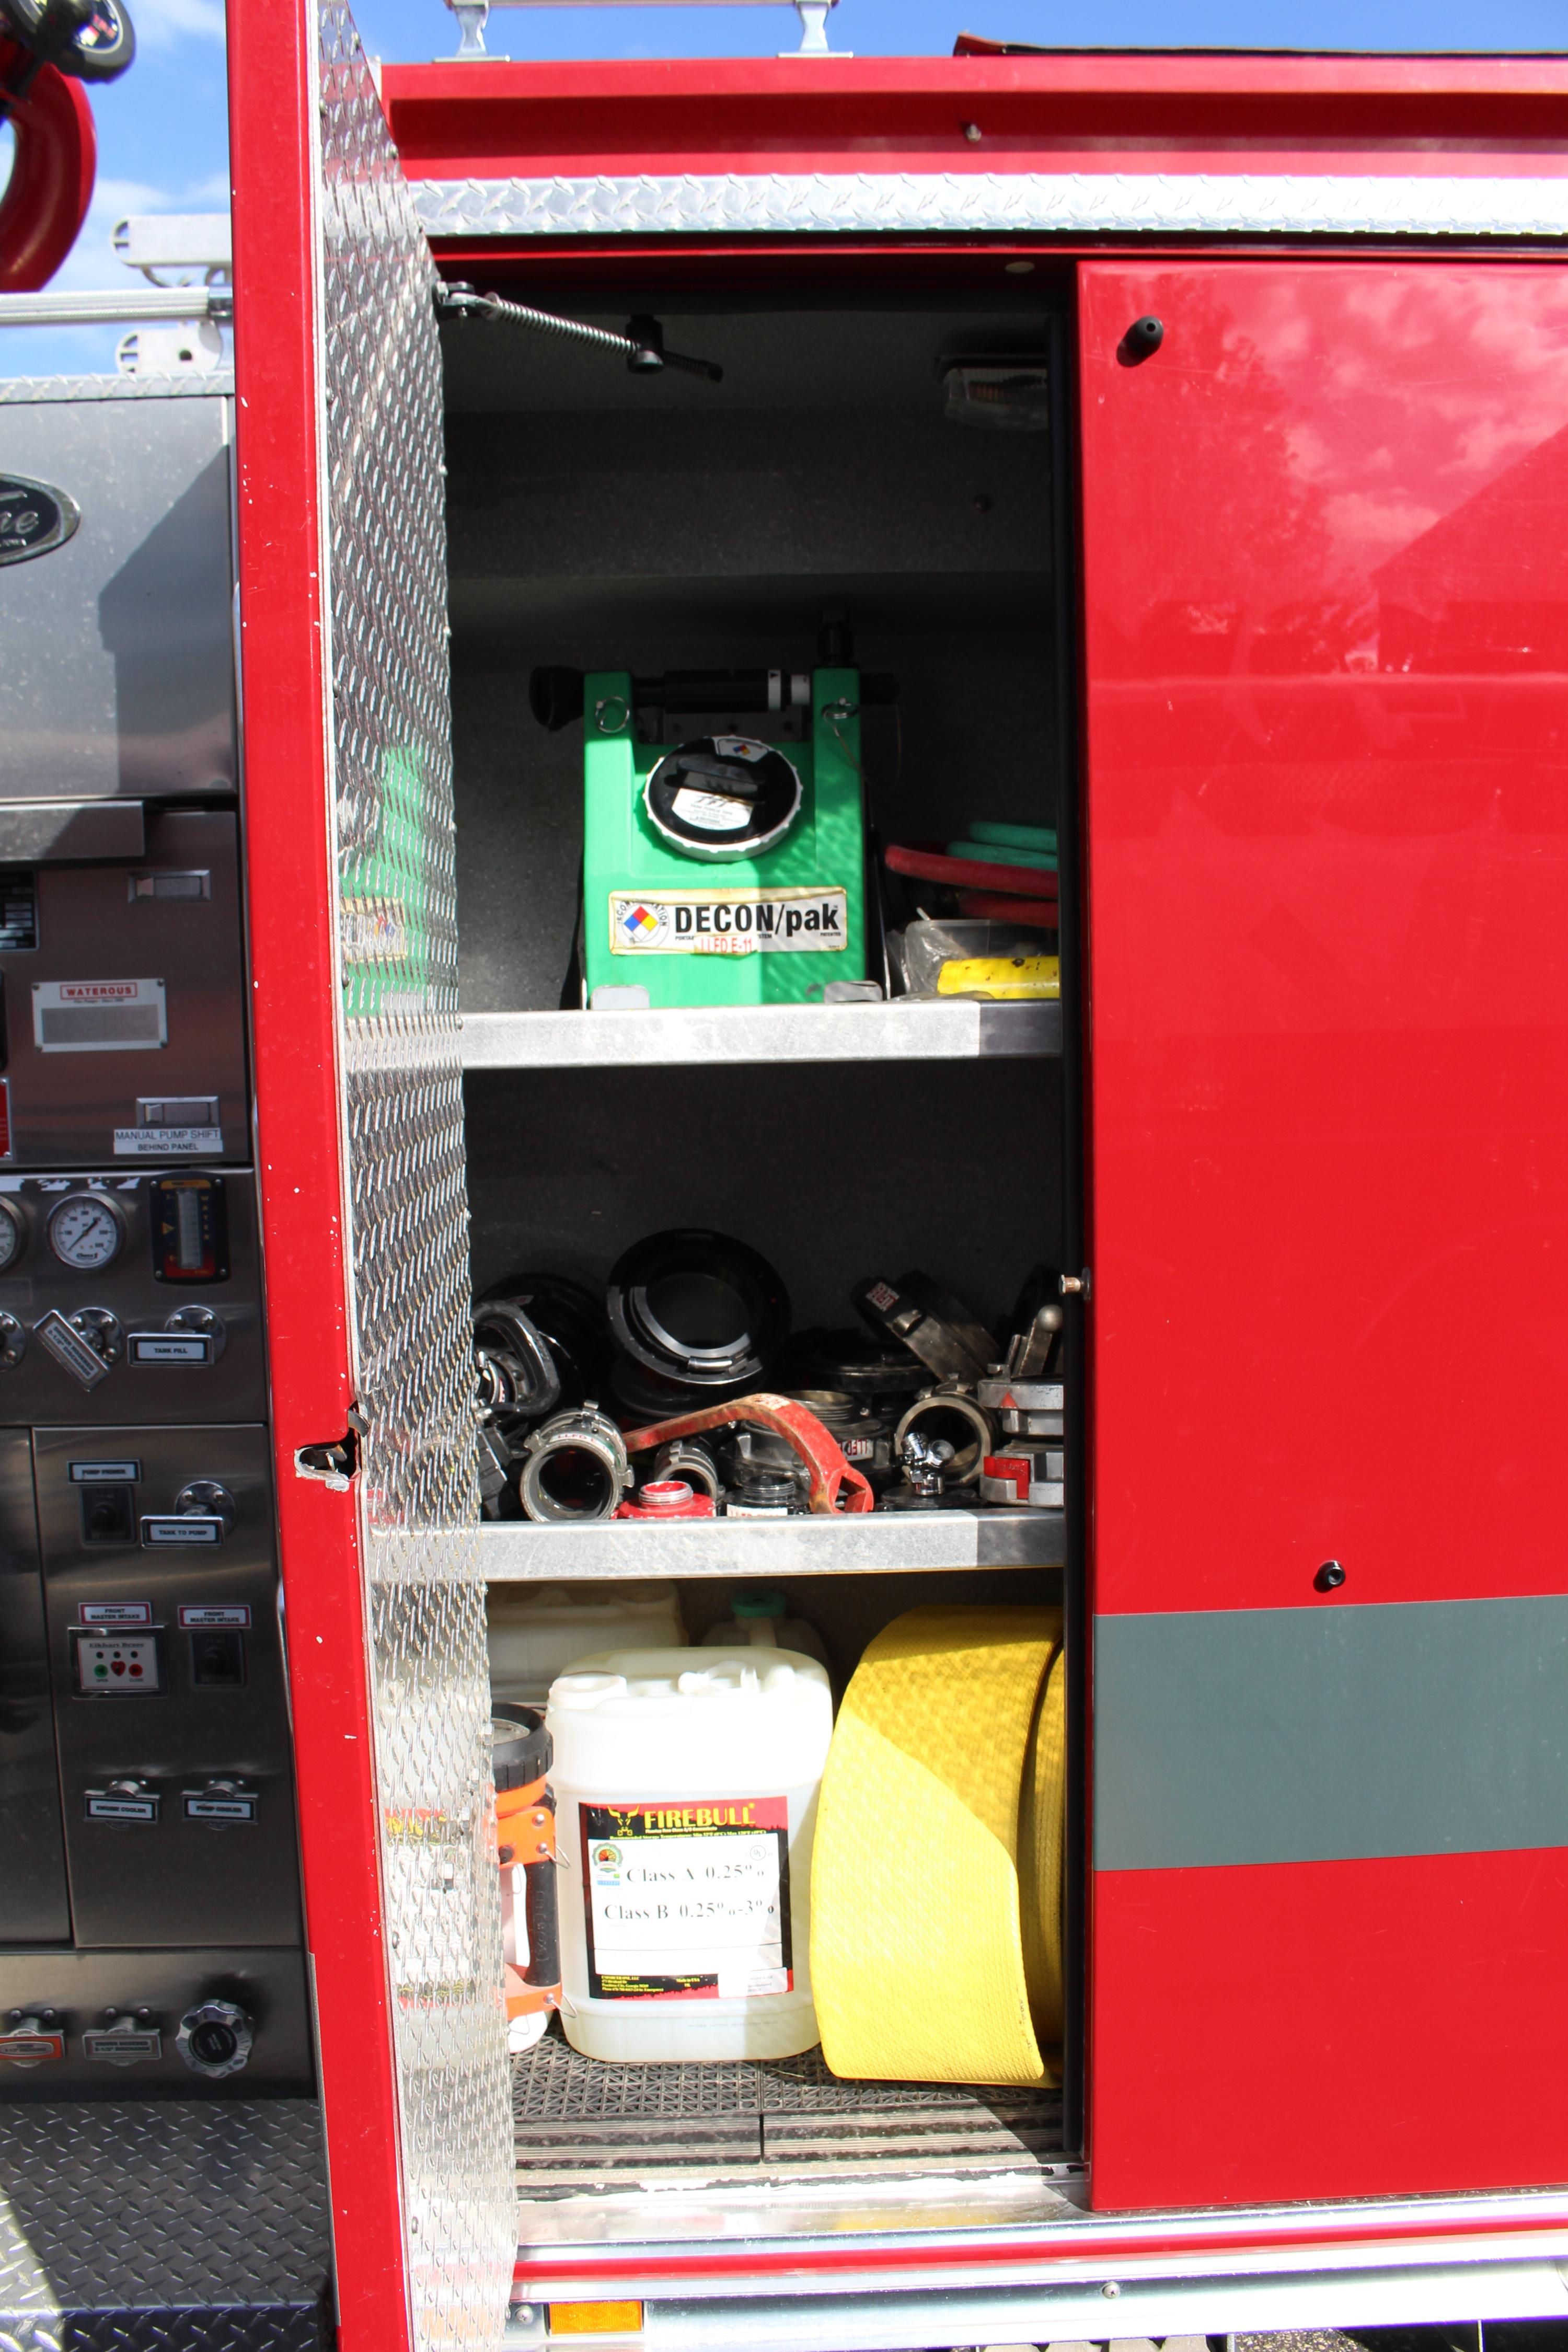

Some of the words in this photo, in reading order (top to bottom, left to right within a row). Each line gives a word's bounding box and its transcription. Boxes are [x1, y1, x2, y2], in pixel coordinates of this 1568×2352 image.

[66, 986, 132, 996] WATEROUS
[116, 1131, 156, 1140] MANUAL
[159, 1131, 188, 1139] PUMP
[190, 1129, 219, 1138] SHIFT
[644, 1806, 756, 1829] FIREBULL
[627, 1868, 675, 1882] Class
[604, 1904, 650, 1919] Class
[657, 1904, 668, 1919] B
